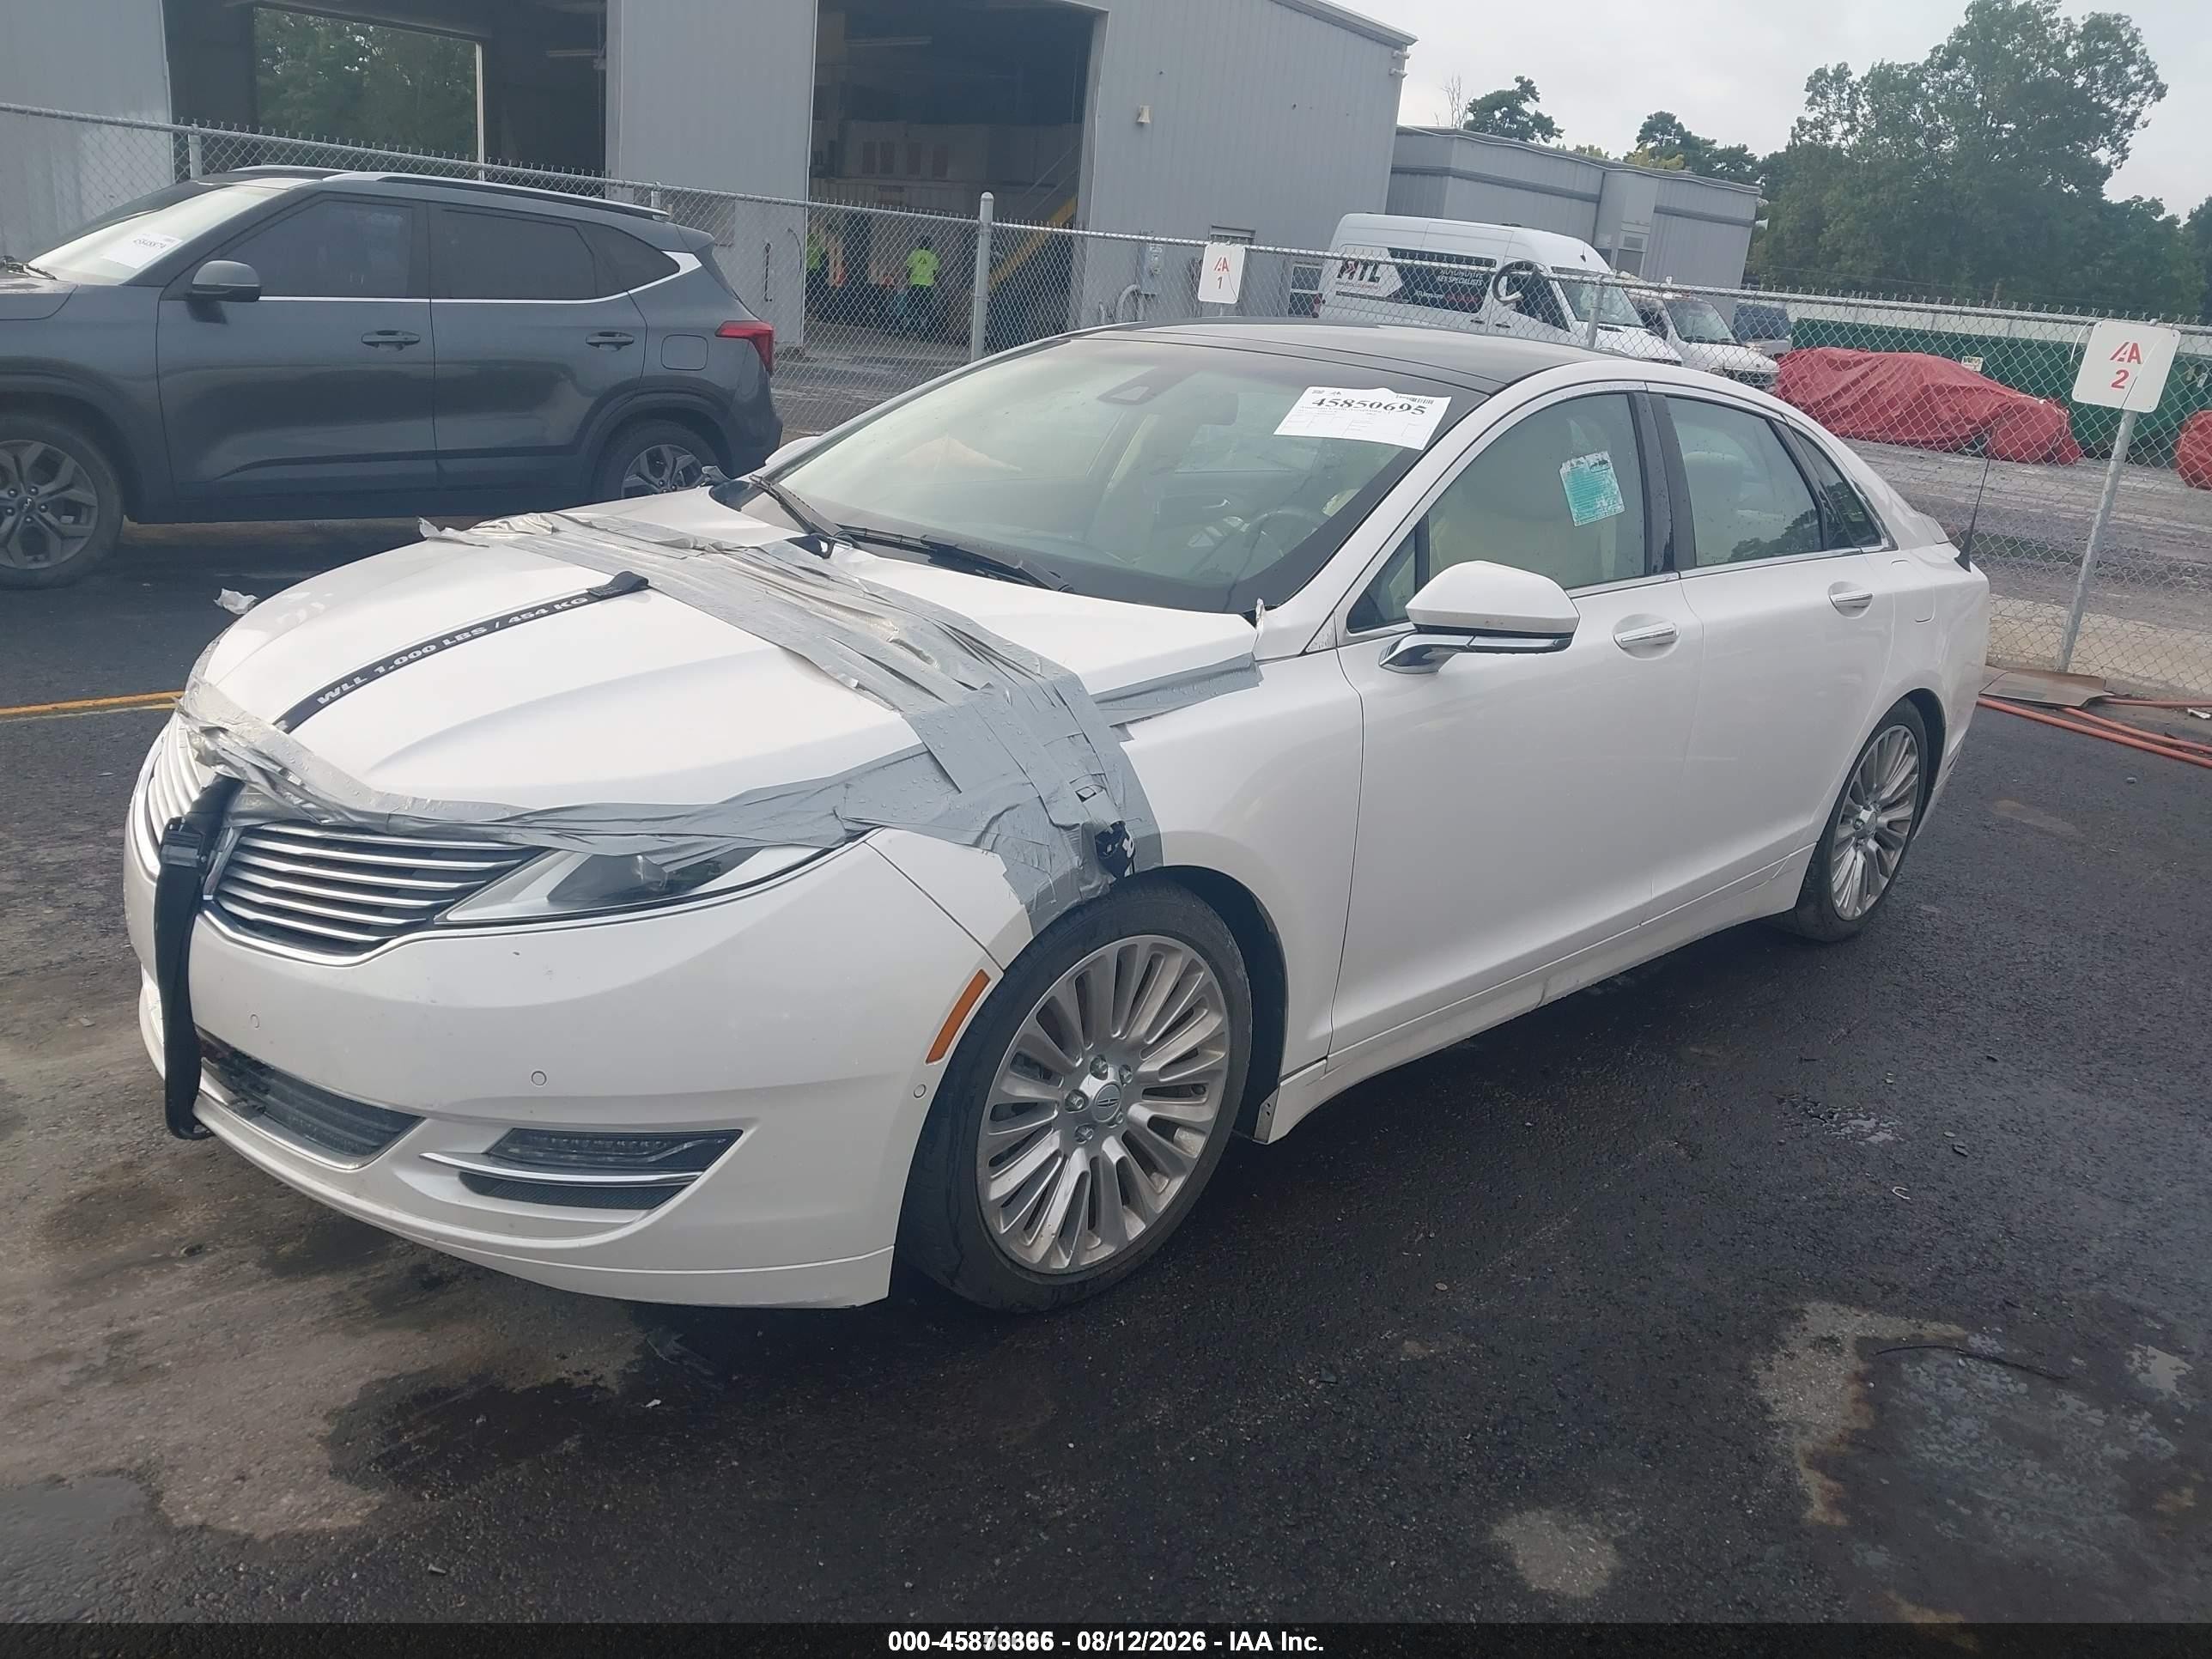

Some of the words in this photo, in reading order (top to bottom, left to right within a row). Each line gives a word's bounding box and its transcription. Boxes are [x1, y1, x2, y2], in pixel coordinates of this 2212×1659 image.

[1217, 276, 1223, 289] 1
[2111, 369, 2130, 389] 2
[1311, 398, 1427, 415] 45850695
[317, 676, 368, 704] WLL
[442, 627, 487, 646] LBS
[508, 608, 550, 624] 454
[554, 597, 589, 610] KG
